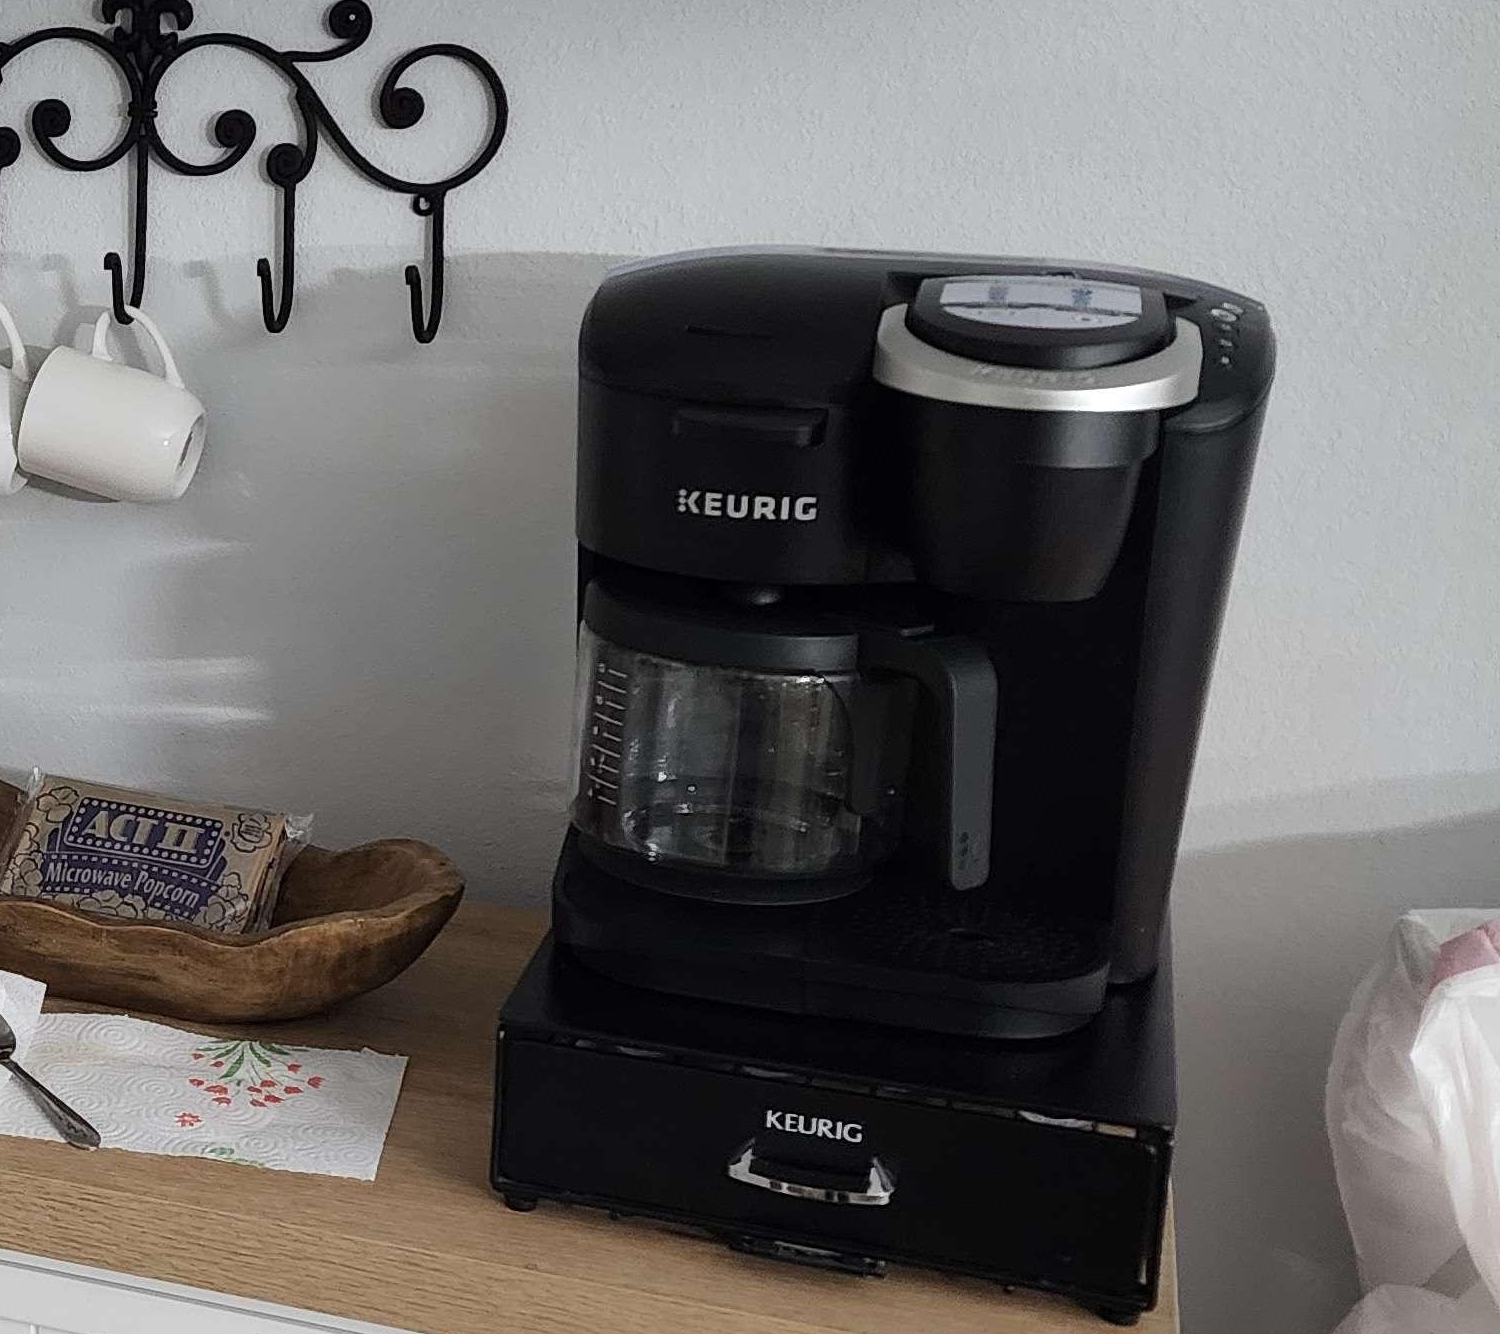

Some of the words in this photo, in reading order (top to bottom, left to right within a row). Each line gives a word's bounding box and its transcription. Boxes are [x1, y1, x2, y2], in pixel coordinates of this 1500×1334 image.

[678, 489, 817, 521] KEURIG
[83, 810, 159, 845] ACT
[155, 821, 206, 855] II
[45, 861, 133, 889] Microwave
[133, 869, 201, 910] Popcorn
[765, 1109, 863, 1144] KEURIG
